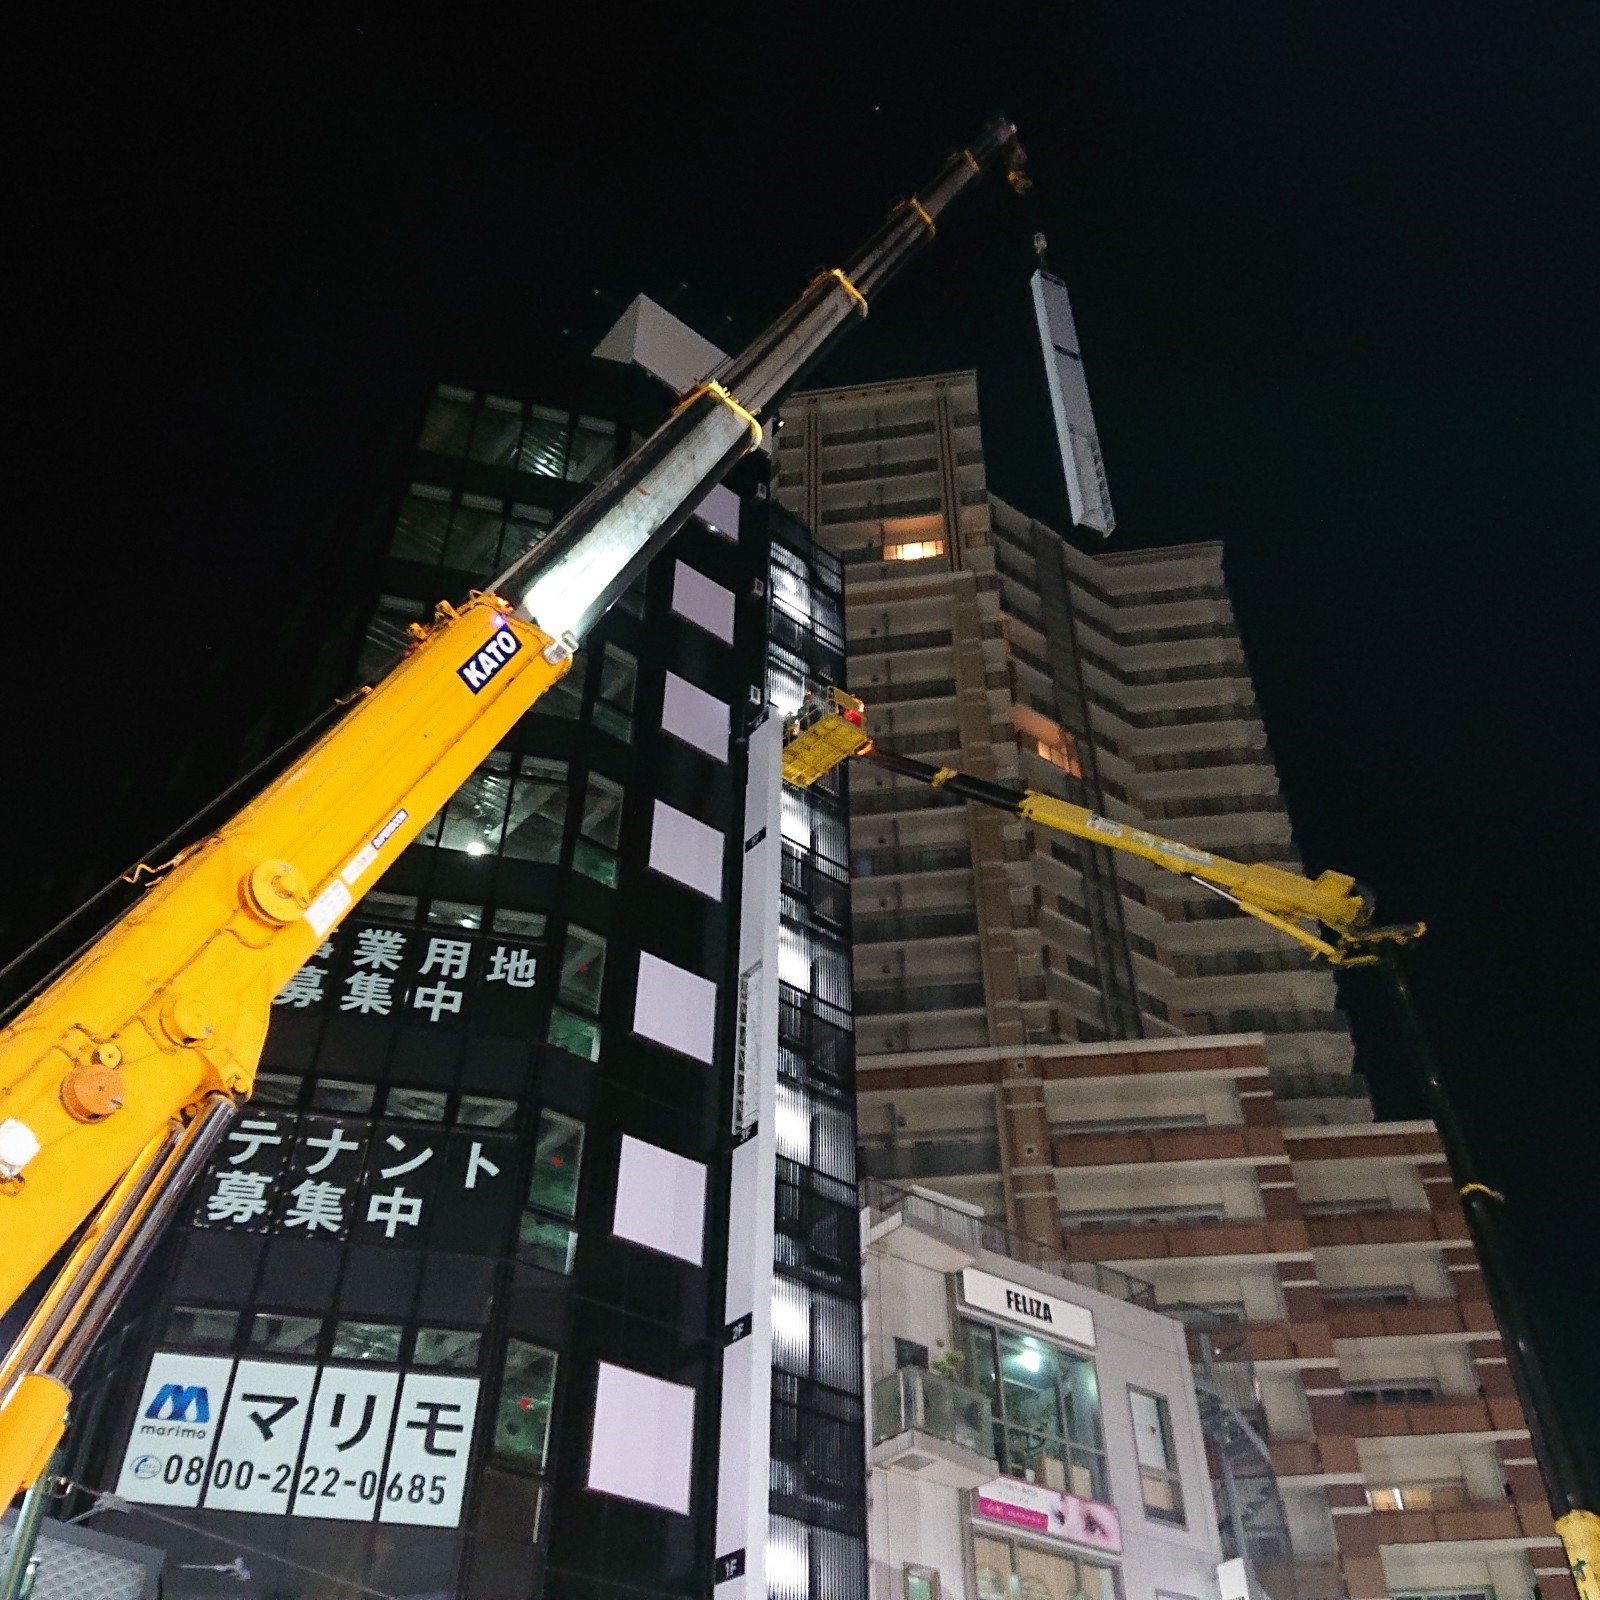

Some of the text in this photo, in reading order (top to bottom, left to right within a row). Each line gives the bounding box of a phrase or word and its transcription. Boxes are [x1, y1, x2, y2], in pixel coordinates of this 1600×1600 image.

[462, 630, 517, 689] KATO
[314, 927, 538, 989] 業用地
[272, 965, 464, 1023] 募集中
[228, 1119, 501, 1189] テナント
[207, 1170, 424, 1239] 募集中
[1006, 1289, 1054, 1324] FELIZA
[140, 1424, 207, 1441] marimo
[241, 1392, 465, 1458] マリモ
[163, 1453, 447, 1506] 0800-222-0685
[725, 1558, 738, 1578] 1F
